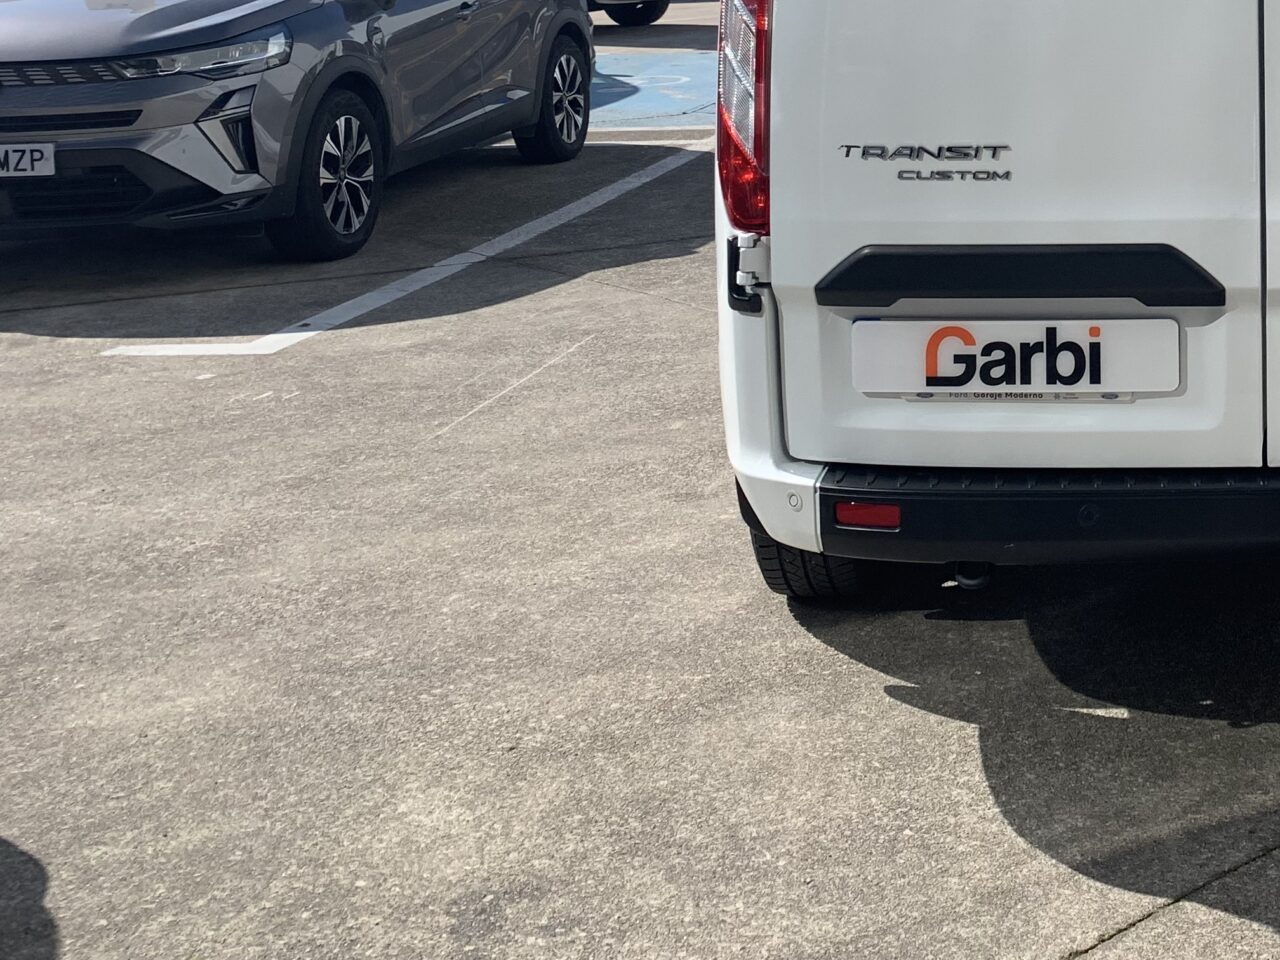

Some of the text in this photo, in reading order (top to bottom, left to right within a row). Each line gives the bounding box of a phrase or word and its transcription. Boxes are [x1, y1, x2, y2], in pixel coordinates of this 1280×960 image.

[838, 145, 1012, 161] TRANSIT
[897, 170, 1012, 181] CUSTOM
[925, 326, 1101, 387] Garbi
[973, 392, 1003, 400] Garaje
